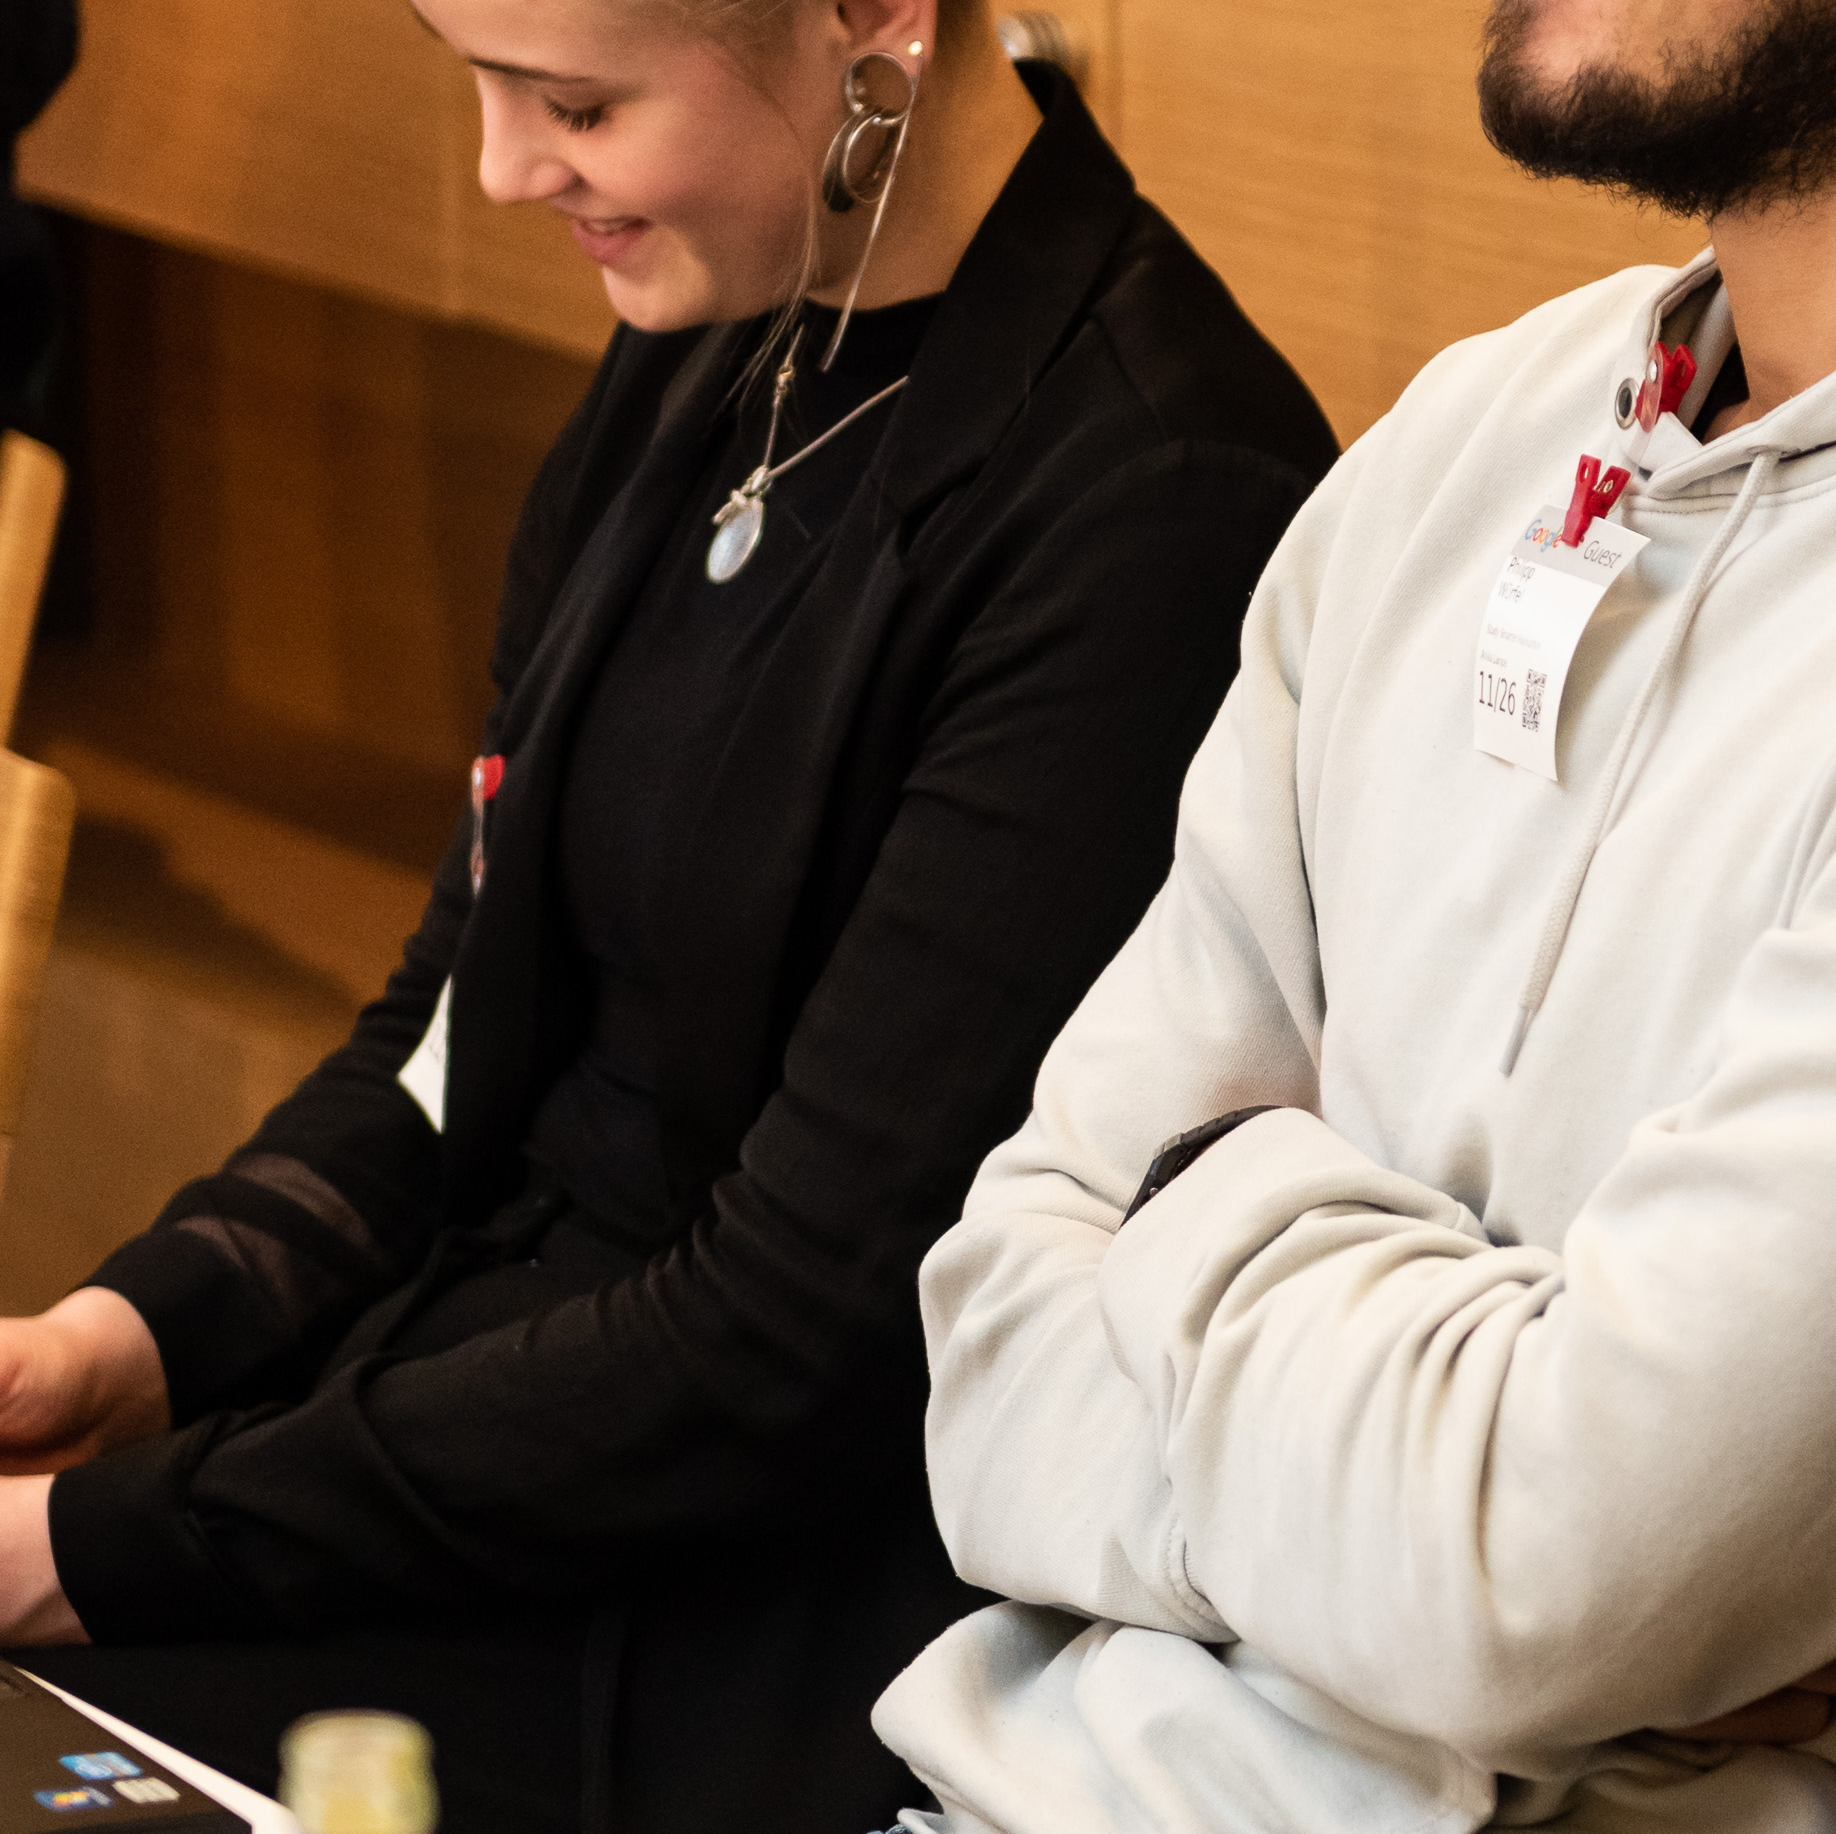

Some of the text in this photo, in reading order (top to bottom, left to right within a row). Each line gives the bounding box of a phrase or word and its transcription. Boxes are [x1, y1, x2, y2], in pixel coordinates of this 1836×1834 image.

[1525, 518, 1563, 553] Google
[1583, 540, 1622, 569] Guest
[1479, 670, 1517, 716] 11/26
